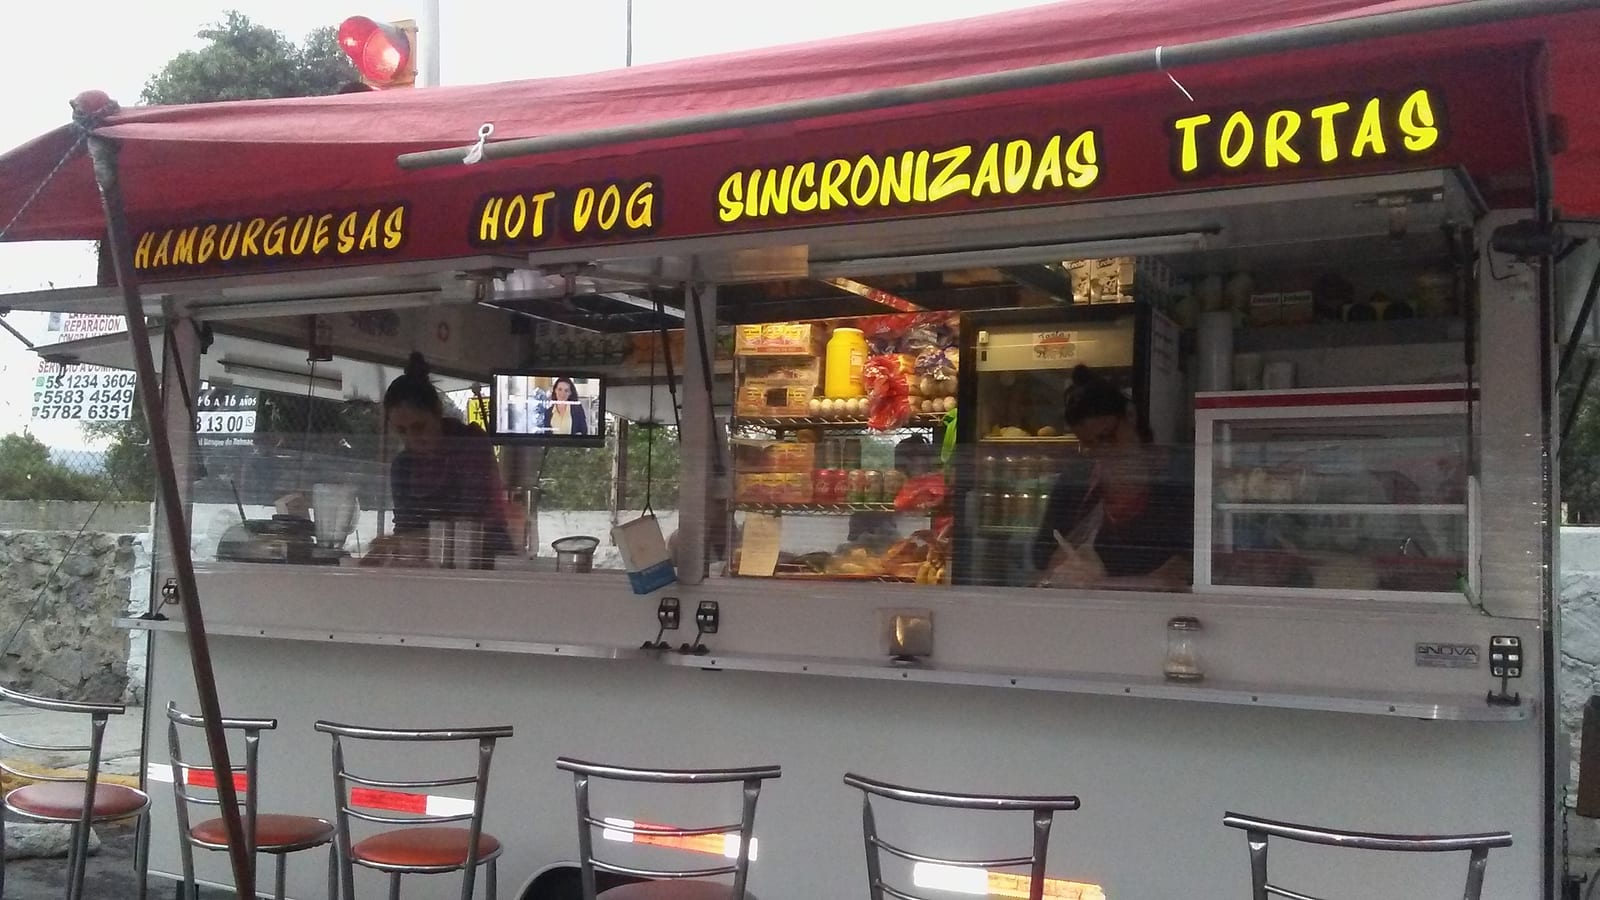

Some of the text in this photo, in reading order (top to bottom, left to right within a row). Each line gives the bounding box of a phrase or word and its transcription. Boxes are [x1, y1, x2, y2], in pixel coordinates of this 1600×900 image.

[134, 89, 1440, 269] HAMBURGUESAS HOT DOG SINCRONIZADAS TORTAS
[64, 319, 122, 332] REPARACION
[67, 374, 98, 389] 1234
[102, 373, 136, 389] 3604
[43, 389, 132, 404] 5583 4549
[214, 398, 220, 407] A
[225, 395, 236, 407] 16
[40, 405, 130, 419] 5782 6351
[207, 416, 223, 432] 13
[227, 416, 243, 432] 00
